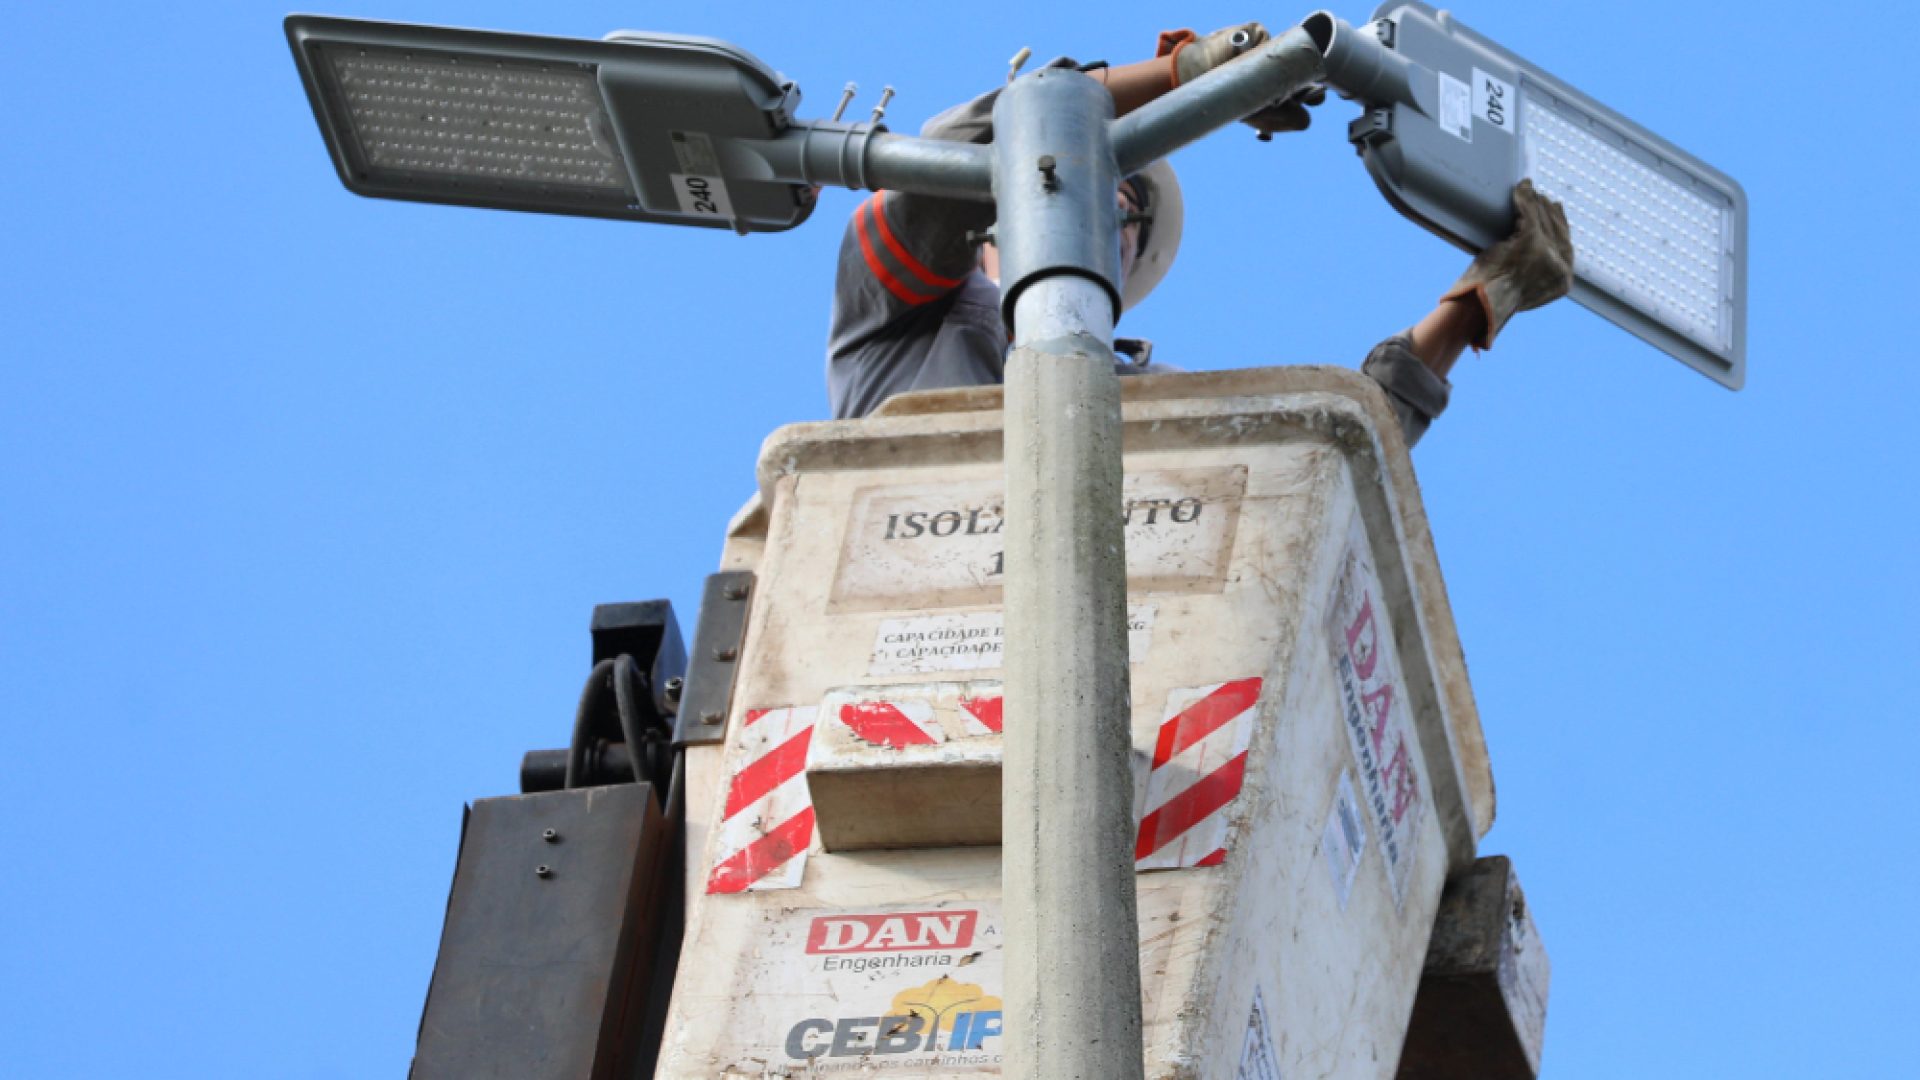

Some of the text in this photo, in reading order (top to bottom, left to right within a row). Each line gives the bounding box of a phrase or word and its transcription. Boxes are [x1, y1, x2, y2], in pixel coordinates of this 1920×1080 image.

[1485, 78, 1504, 126] 240
[685, 177, 718, 214] 240
[884, 626, 990, 643] CAPACIDADE
[896, 641, 1003, 658] CAPACIDADE
[1345, 589, 1419, 826] DAN
[1339, 653, 1398, 866] Engenharia
[817, 914, 969, 951] DAN
[822, 953, 952, 974] Engenharia
